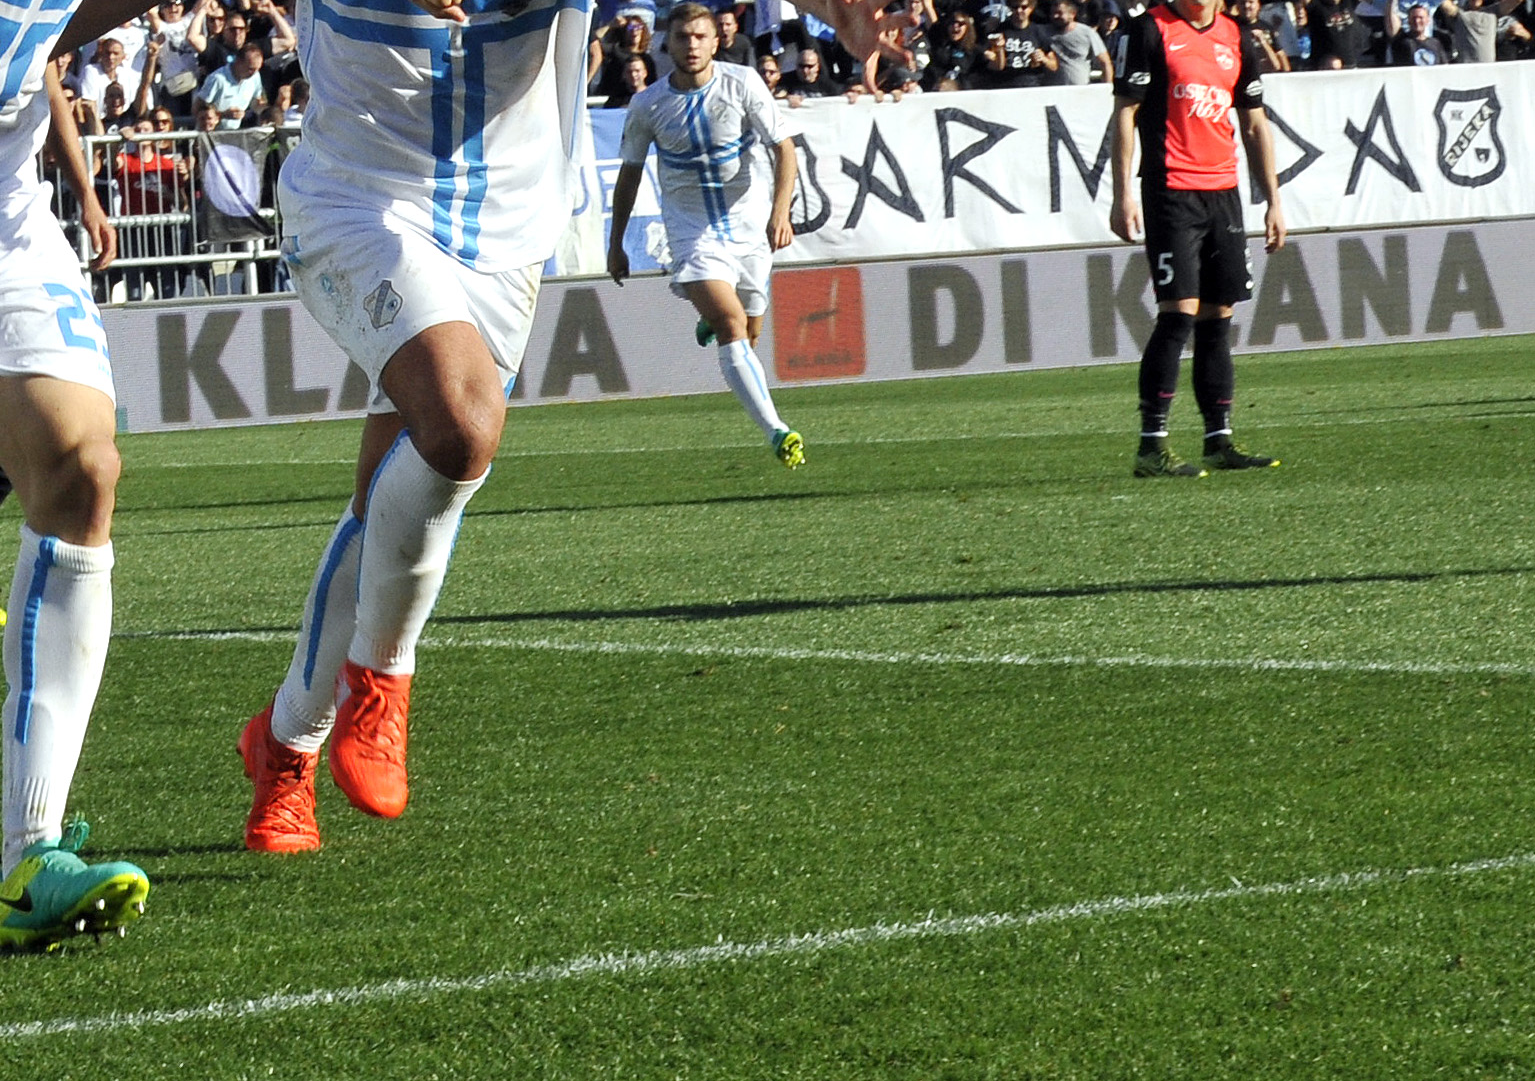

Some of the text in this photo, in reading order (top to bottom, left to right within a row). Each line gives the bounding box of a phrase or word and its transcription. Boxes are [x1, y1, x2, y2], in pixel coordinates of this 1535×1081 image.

[841, 83, 1423, 229] ARMDA
[907, 230, 1506, 372] DI KANA
[1157, 251, 1175, 286] 5
[156, 288, 630, 423] KLA
